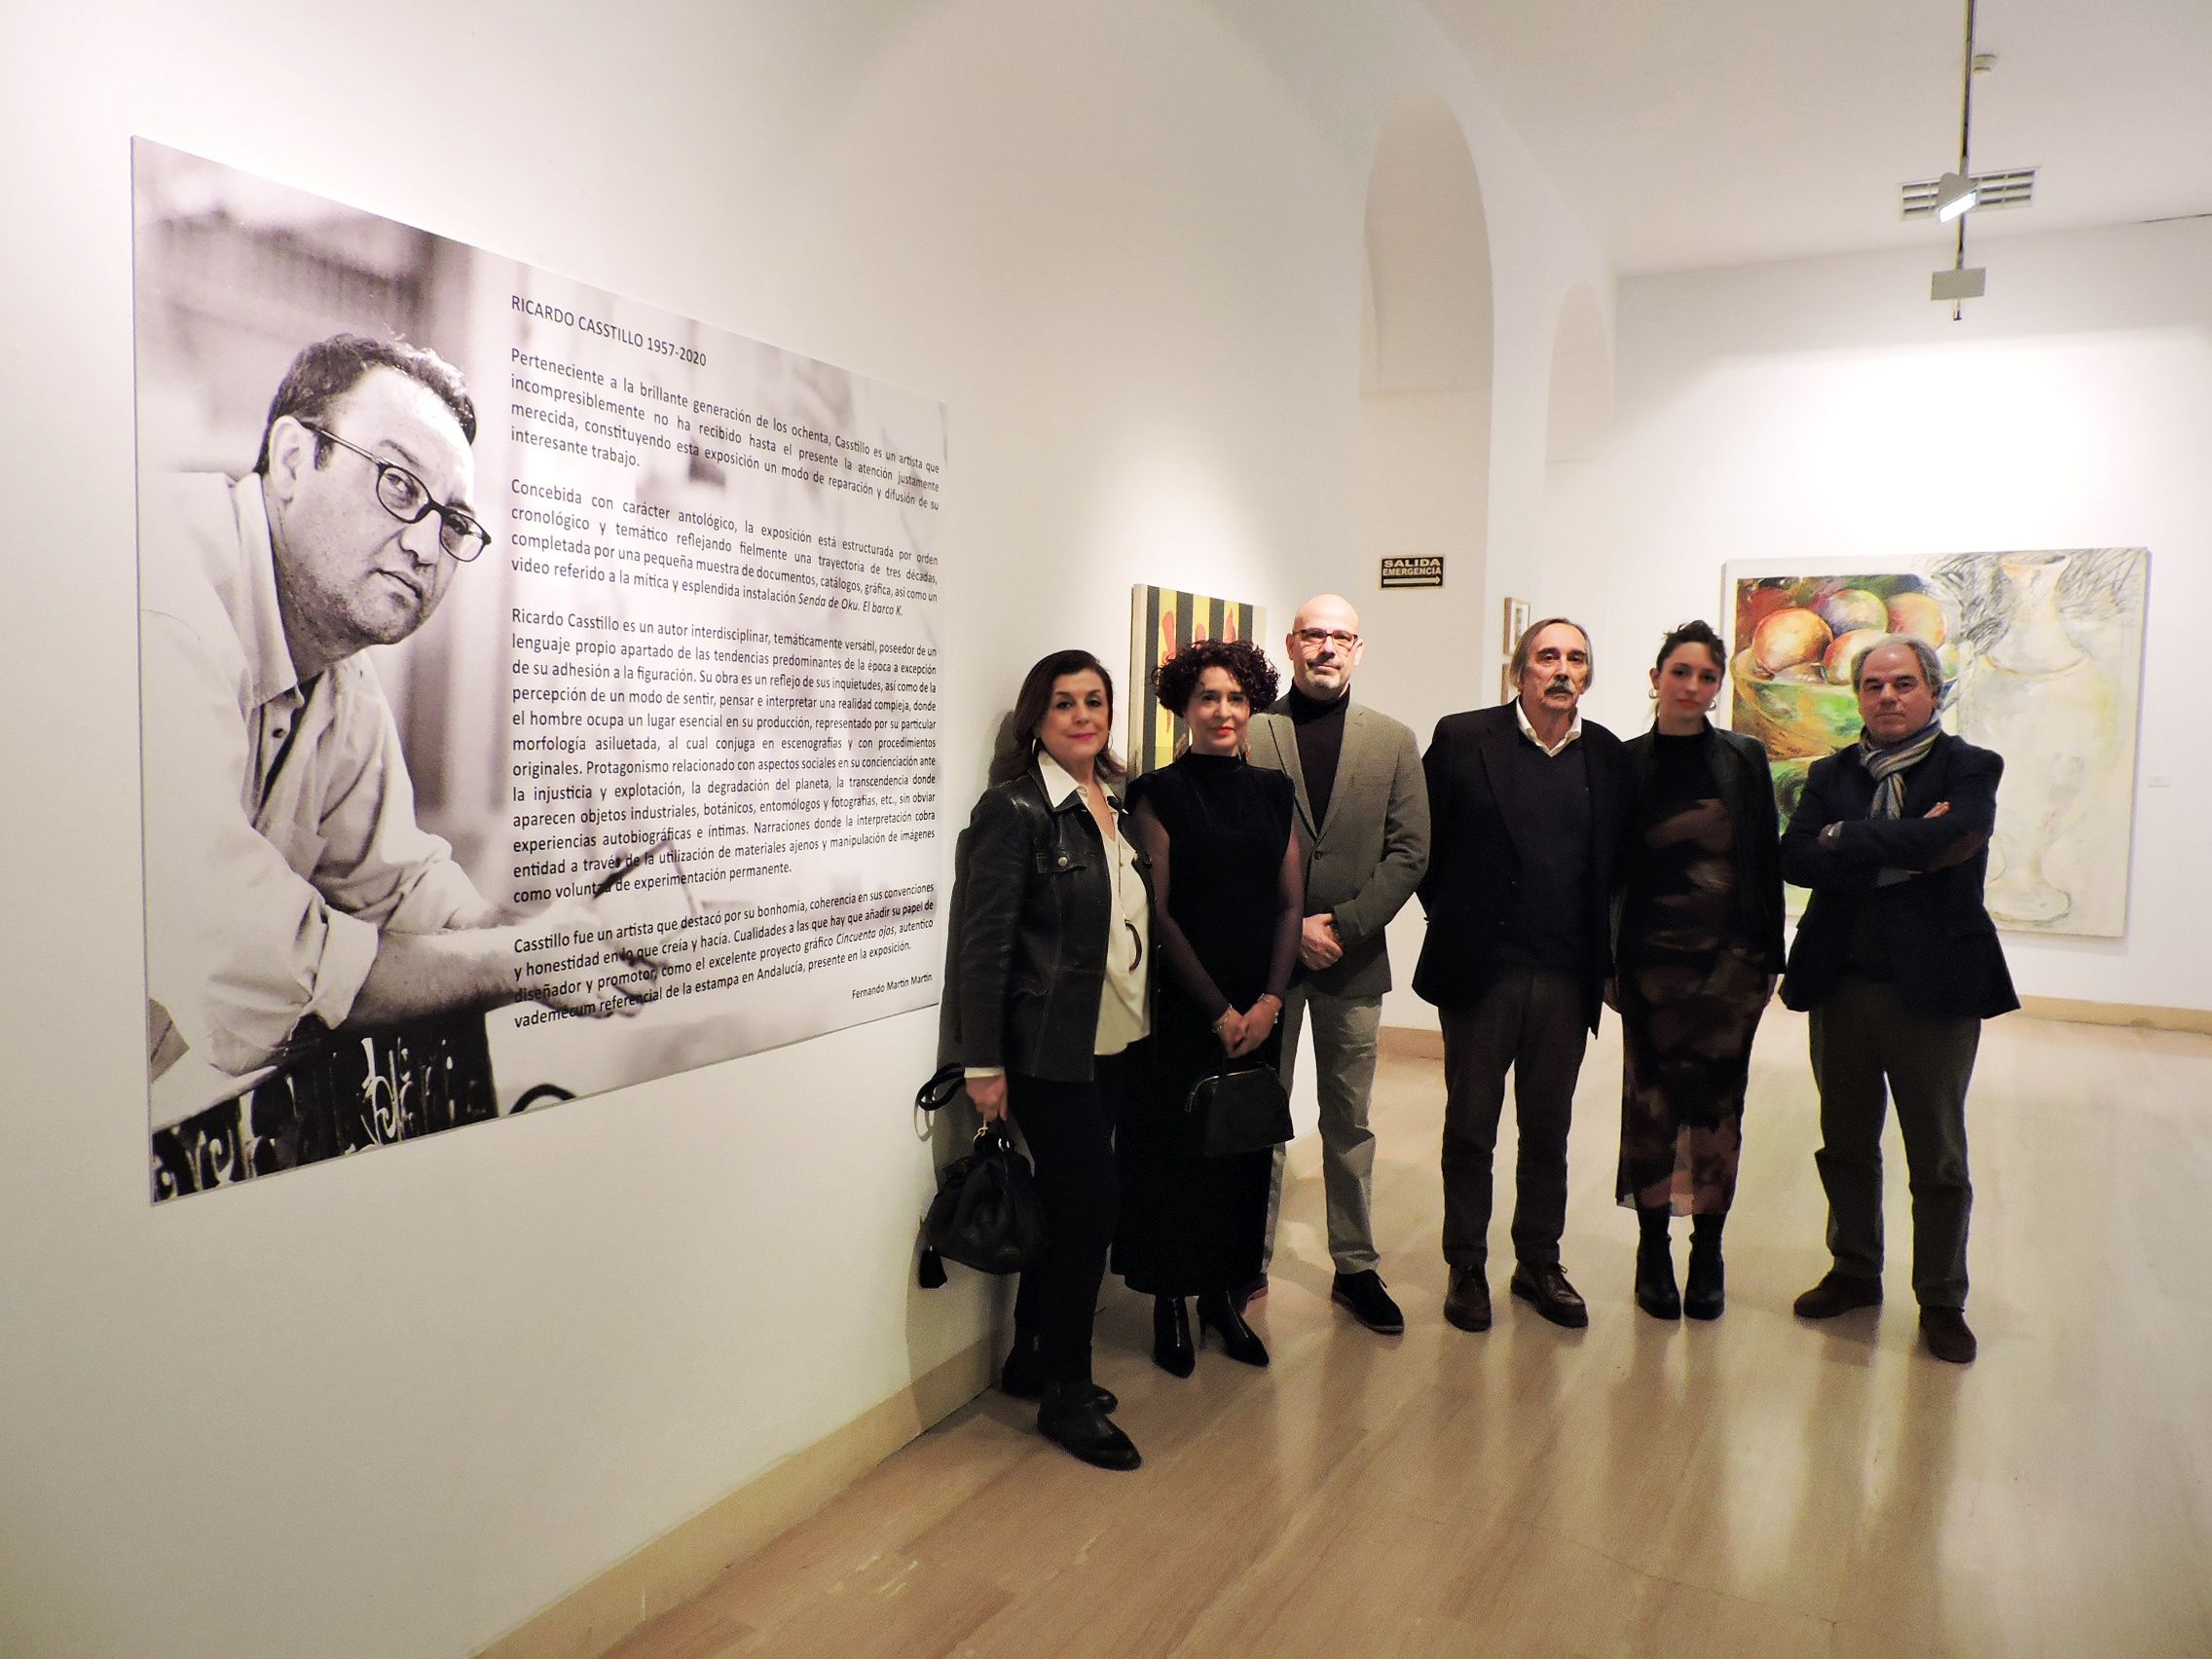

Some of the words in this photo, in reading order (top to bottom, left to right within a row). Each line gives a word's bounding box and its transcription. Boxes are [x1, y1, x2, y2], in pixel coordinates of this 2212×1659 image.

[511, 295, 574, 328] RICARDO
[578, 315, 644, 349] CASSTILLO
[646, 337, 706, 367] 1957-2020
[511, 348, 604, 386] Perteneciente
[640, 381, 688, 408] brillante
[693, 399, 751, 424] generación
[791, 424, 830, 447] ochenta,
[834, 435, 869, 456] Casstillo
[899, 455, 922, 469] artista
[511, 373, 645, 421] incompresiblemente
[699, 424, 742, 444] recibido
[749, 432, 776, 452] hasta
[798, 449, 838, 467] presente
[858, 462, 892, 481] atención
[898, 470, 939, 492] justamente
[511, 425, 588, 457] interesante
[591, 444, 639, 468] trabajo.
[511, 403, 578, 431] merecida,
[584, 420, 671, 450] constituyendo
[676, 441, 699, 457] esta
[704, 448, 759, 470] exposición
[781, 465, 810, 481] modo
[828, 477, 873, 496] reparación
[884, 486, 915, 505] difusión
[511, 478, 581, 504] Concebida
[622, 499, 670, 520] carácter
[678, 511, 737, 534] antológico,
[760, 526, 811, 544] exposición
[818, 535, 836, 548] está
[842, 540, 894, 558] estructurada
[916, 551, 938, 566] orden
[511, 507, 589, 532] cronológico
[615, 522, 668, 542] temático
[677, 532, 731, 552] reflejando
[739, 539, 787, 561] fielmente
[818, 554, 865, 572] trayectoria
[886, 566, 901, 578] tres
[905, 567, 937, 586] décadas,
[511, 534, 590, 555] completada
[644, 552, 692, 569] pequeña
[696, 560, 739, 575] muestra
[756, 564, 818, 588] documentos,
[820, 575, 863, 594] catálogos,
[864, 581, 893, 598] gráfica,
[1383, 558, 1441, 568] SALIDA
[554, 562, 605, 581] referido
[633, 571, 669, 589] mítica
[742, 584, 795, 604] instalación
[797, 592, 826, 608] Senda
[871, 601, 894, 615] barco
[1382, 567, 1442, 576] EMERGENCIA
[512, 608, 563, 626] Ricardo
[568, 612, 619, 631] Casstillo
[657, 623, 688, 637] autor
[691, 623, 771, 645] interdisciplinar,
[773, 632, 843, 649] temáticamente
[844, 639, 877, 654] versátil,
[878, 643, 914, 655] poseedor
[512, 632, 570, 655] lenguaje
[575, 640, 616, 658] propio
[620, 643, 674, 660] apartado
[714, 648, 769, 665] tendencias
[772, 652, 841, 669] predominantes
[900, 663, 936, 678] excepción
[512, 685, 586, 705] percepción
[682, 691, 716, 708] sentir,
[719, 696, 755, 709] pensar
[765, 694, 817, 711] interpretar
[838, 697, 872, 710] realidad
[873, 698, 911, 714] compleja,
[912, 699, 936, 712] donde
[551, 660, 609, 679] adhesión
[637, 665, 696, 683] figuración.
[715, 670, 738, 684] obra
[769, 673, 800, 690] reflejo
[831, 677, 883, 693] inquietudes,
[530, 710, 582, 726] hombre
[586, 716, 624, 730] ocupa
[646, 712, 676, 730] lugar
[679, 714, 722, 727] esencial
[756, 715, 812, 731] producción,
[815, 717, 872, 732] representado
[901, 718, 936, 732] particular
[512, 735, 586, 755] morfología
[595, 735, 660, 753] asiluetada,
[685, 736, 708, 750] cual
[716, 736, 755, 753] conjuga
[878, 736, 936, 751] procedimientos
[512, 760, 582, 780] originales.
[586, 759, 669, 778] Protagonismo
[672, 757, 734, 772] relacionado
[757, 758, 799, 773] aspectos
[801, 756, 836, 769] sociales
[861, 755, 918, 767] concienciación
[919, 756, 936, 766] ante
[512, 814, 575, 830] aparecen
[580, 807, 626, 827] objetos
[630, 803, 700, 820] industriales,
[703, 800, 756, 816] botánicos,
[759, 797, 820, 813] entomólogos
[880, 794, 897, 806] etc.,
[911, 791, 935, 803] obviar
[534, 785, 592, 804] injusticia
[613, 781, 684, 800] explotación,
[707, 778, 769, 796] degradación
[795, 777, 831, 793] planeta,
[848, 774, 908, 788] transcendencia
[912, 772, 936, 785] donde
[512, 833, 597, 856] experiencias
[602, 827, 691, 846] autobiográficas
[708, 824, 749, 837] íntimas.
[754, 819, 810, 833] Narraciones
[813, 815, 841, 830] donde
[857, 810, 911, 828] interpretación
[914, 809, 935, 821] cobra
[512, 859, 566, 878] entidad
[582, 854, 624, 871] través
[657, 846, 715, 865] utilización
[734, 840, 786, 857] materiales
[789, 838, 819, 855] ajenos
[830, 831, 885, 849] manipulación
[900, 828, 935, 842] imágenes
[633, 867, 726, 892] experimentación
[729, 863, 792, 882] permanente.
[513, 933, 571, 954] Casstillo
[615, 923, 653, 939] artista
[680, 910, 721, 930] destacó
[809, 893, 856, 910] coherencia
[883, 883, 934, 899] convenciones
[526, 951, 600, 977] honestidad
[659, 938, 688, 955] creía
[700, 932, 730, 948] hacía.
[733, 923, 787, 942] Cualidades
[864, 906, 890, 921] añadir
[902, 900, 923, 917] papel
[514, 980, 582, 1005] diseñador
[597, 970, 660, 993] promotor,
[708, 950, 756, 969] excelente
[759, 942, 801, 963] proyecto
[803, 936, 833, 954] gráfico
[835, 929, 876, 945] Cincuenta
[597, 987, 662, 1013] referencial
[693, 976, 739, 993] estampa
[756, 960, 805, 980] Andalucía,
[807, 954, 845, 974] presente
[868, 940, 910, 959] exposición.
[852, 981, 885, 1000] Fernando
